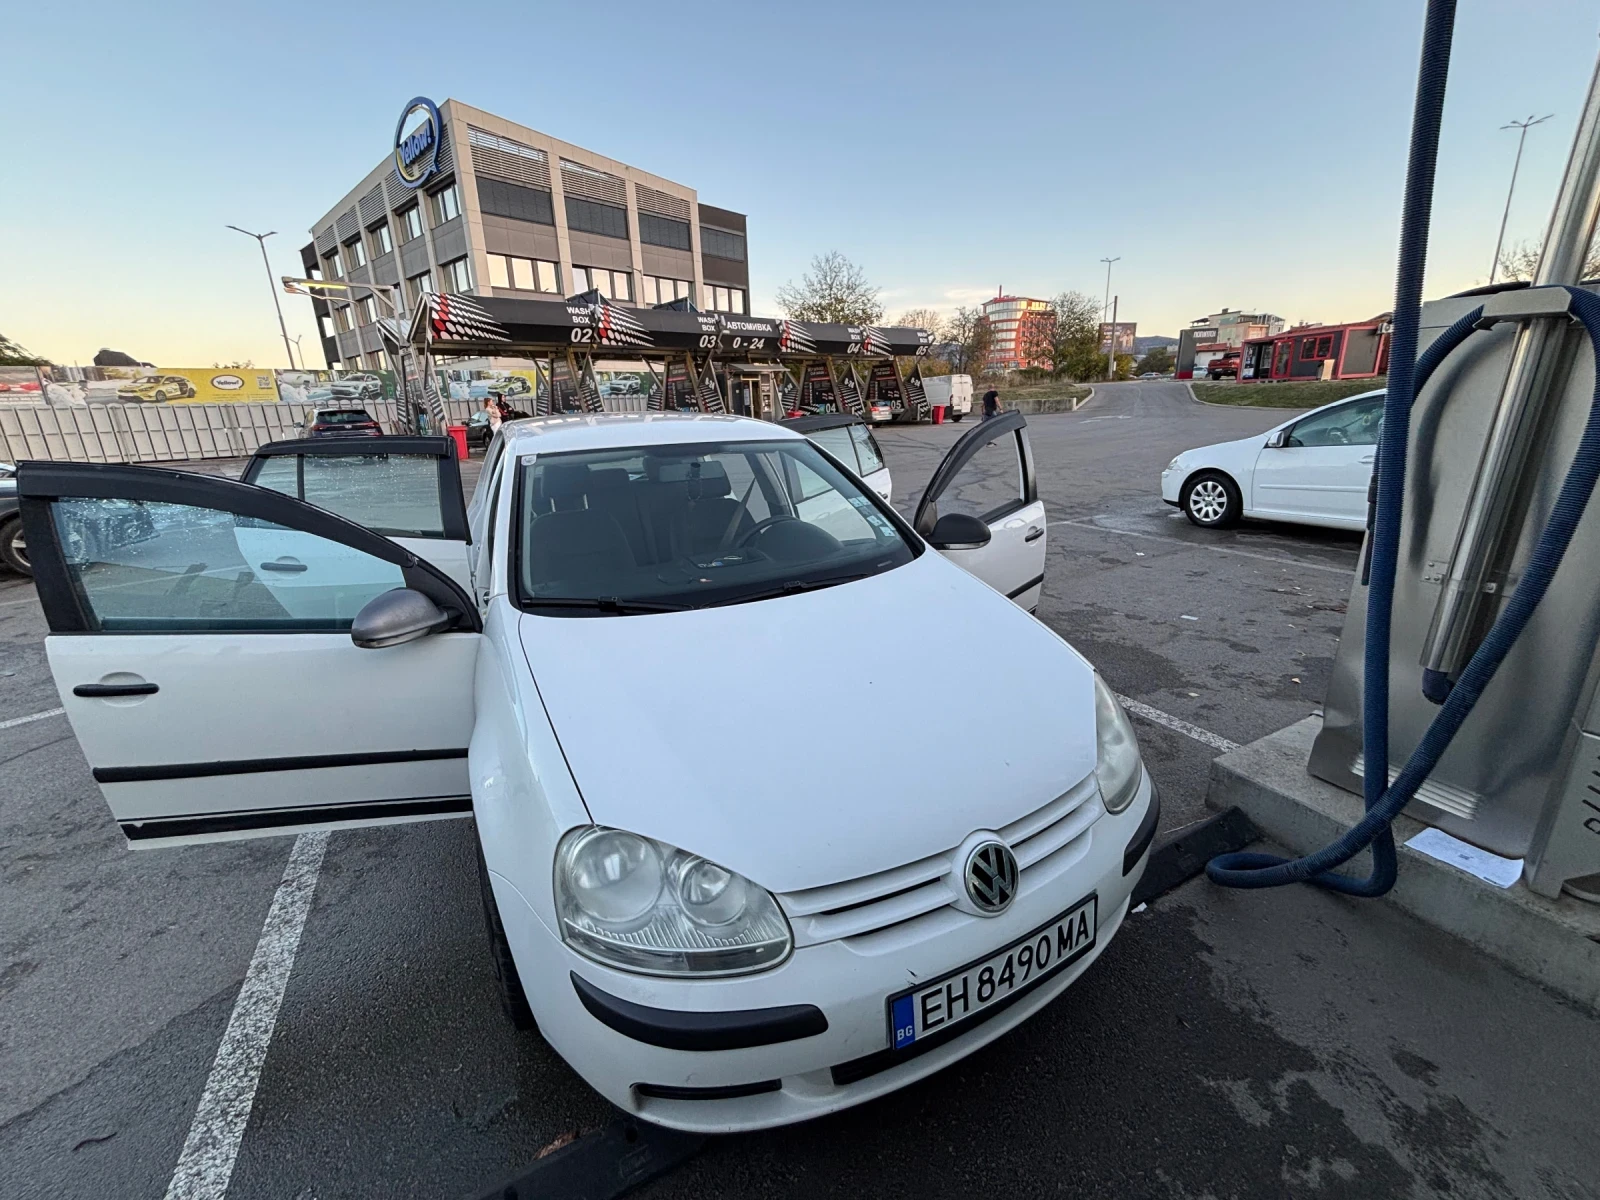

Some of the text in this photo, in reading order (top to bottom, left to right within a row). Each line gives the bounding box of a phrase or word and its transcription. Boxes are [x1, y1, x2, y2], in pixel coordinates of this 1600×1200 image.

[399, 118, 432, 166] Yellow!
[566, 306, 591, 315] WASH
[572, 316, 590, 324] BOX
[697, 316, 716, 324] WASH
[727, 321, 773, 332] АВТОМИВКА
[571, 328, 592, 343] 02
[699, 335, 717, 349] 03
[749, 338, 765, 350] 24
[847, 343, 861, 354] 04
[916, 346, 929, 356] 05
[825, 403, 836, 413] 04
[891, 400, 901, 410] 05
[921, 910, 1089, 1031] EH 8490 MA
[897, 1025, 914, 1041] BG
